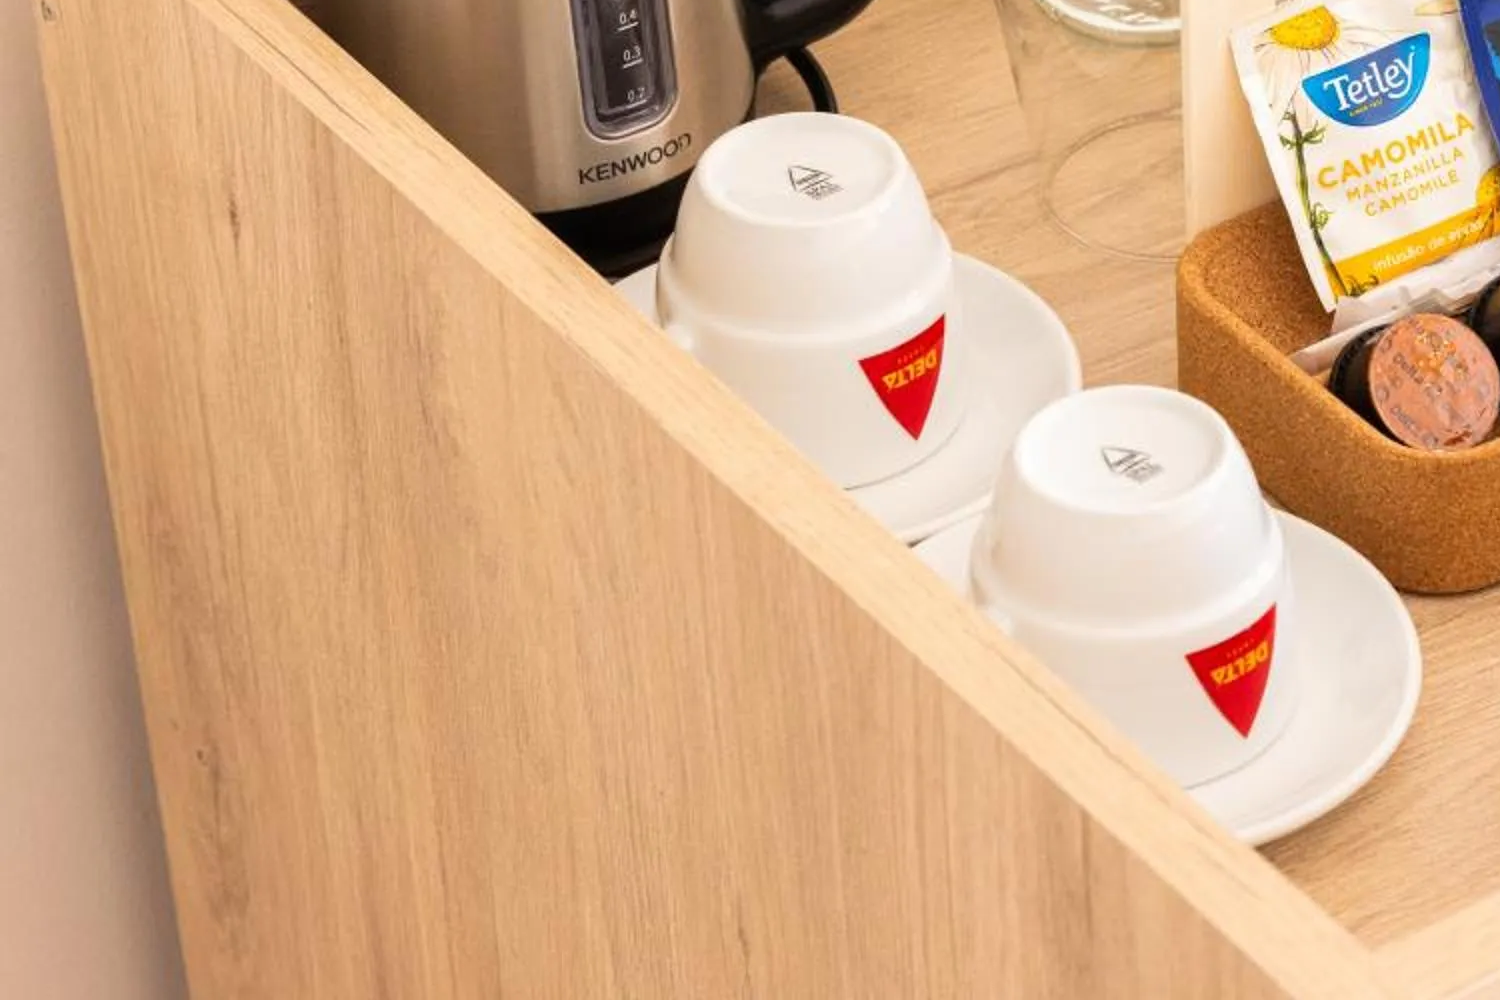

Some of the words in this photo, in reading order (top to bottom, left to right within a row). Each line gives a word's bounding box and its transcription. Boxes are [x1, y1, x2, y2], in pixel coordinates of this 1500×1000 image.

[619, 9, 638, 25] 0.4
[623, 46, 642, 62] 0.3
[1322, 51, 1417, 111] Tetley
[578, 132, 692, 185] KENWOOD
[1317, 112, 1475, 190] CAMOMILA
[1345, 147, 1465, 202] MANZANILLA
[1364, 169, 1460, 218] CAMOMILE
[882, 347, 938, 393] DELTA
[1209, 640, 1269, 688] DELTA
